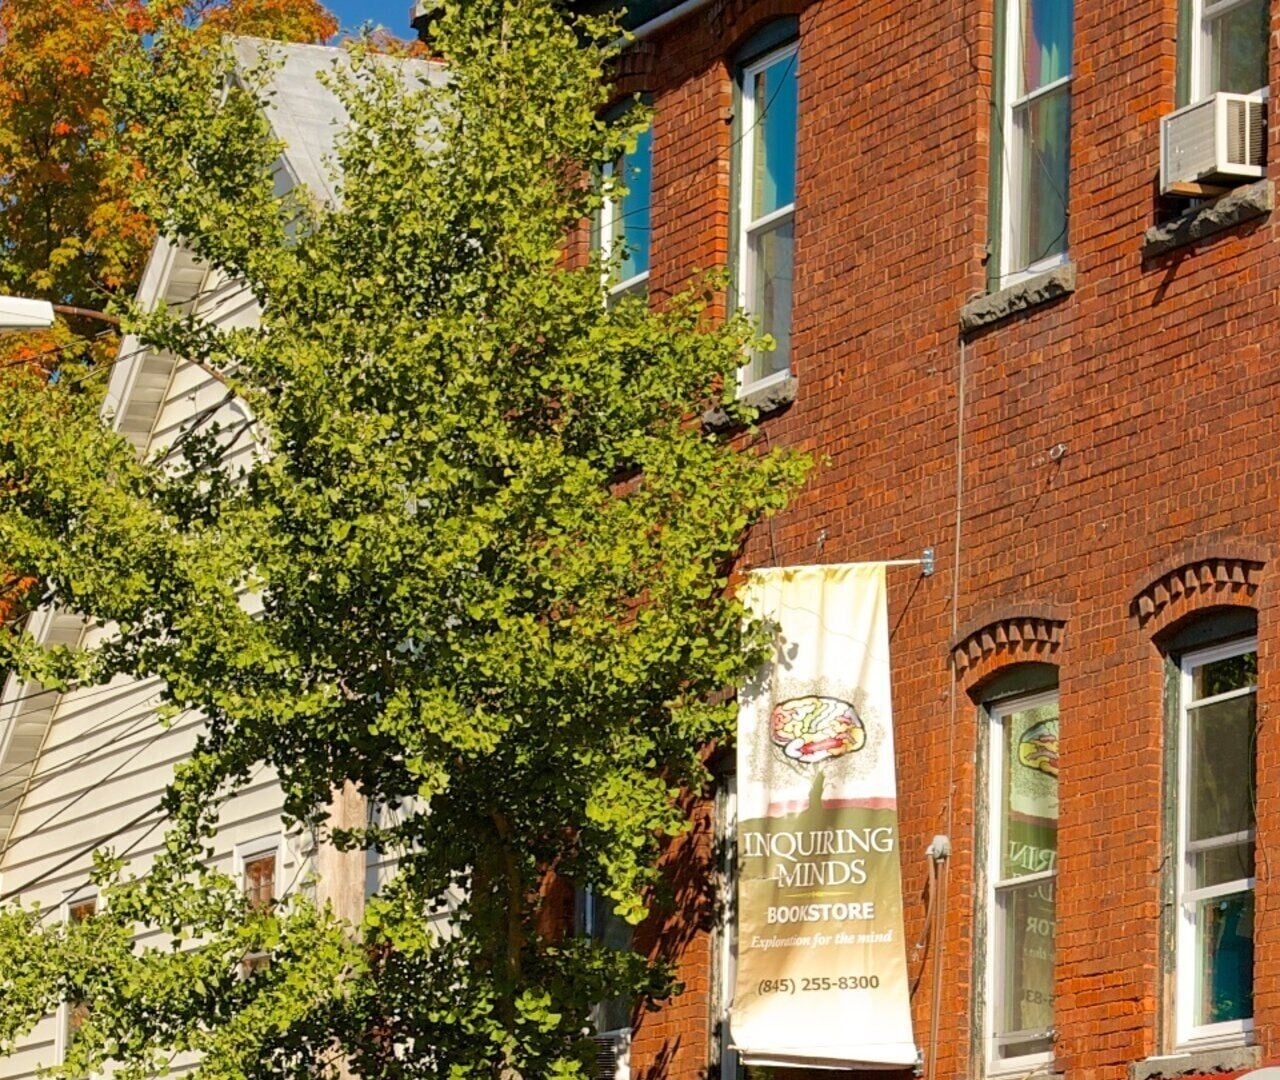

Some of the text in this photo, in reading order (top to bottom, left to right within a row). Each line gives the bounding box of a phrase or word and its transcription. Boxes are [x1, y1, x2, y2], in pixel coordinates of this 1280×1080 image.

[743, 827, 895, 861] INQUIRING
[777, 859, 867, 888] MINDS
[767, 902, 875, 924] BOOKSTORE
[751, 929, 894, 952] Exploration for the mind
[758, 975, 880, 996] (845) 255-8300
